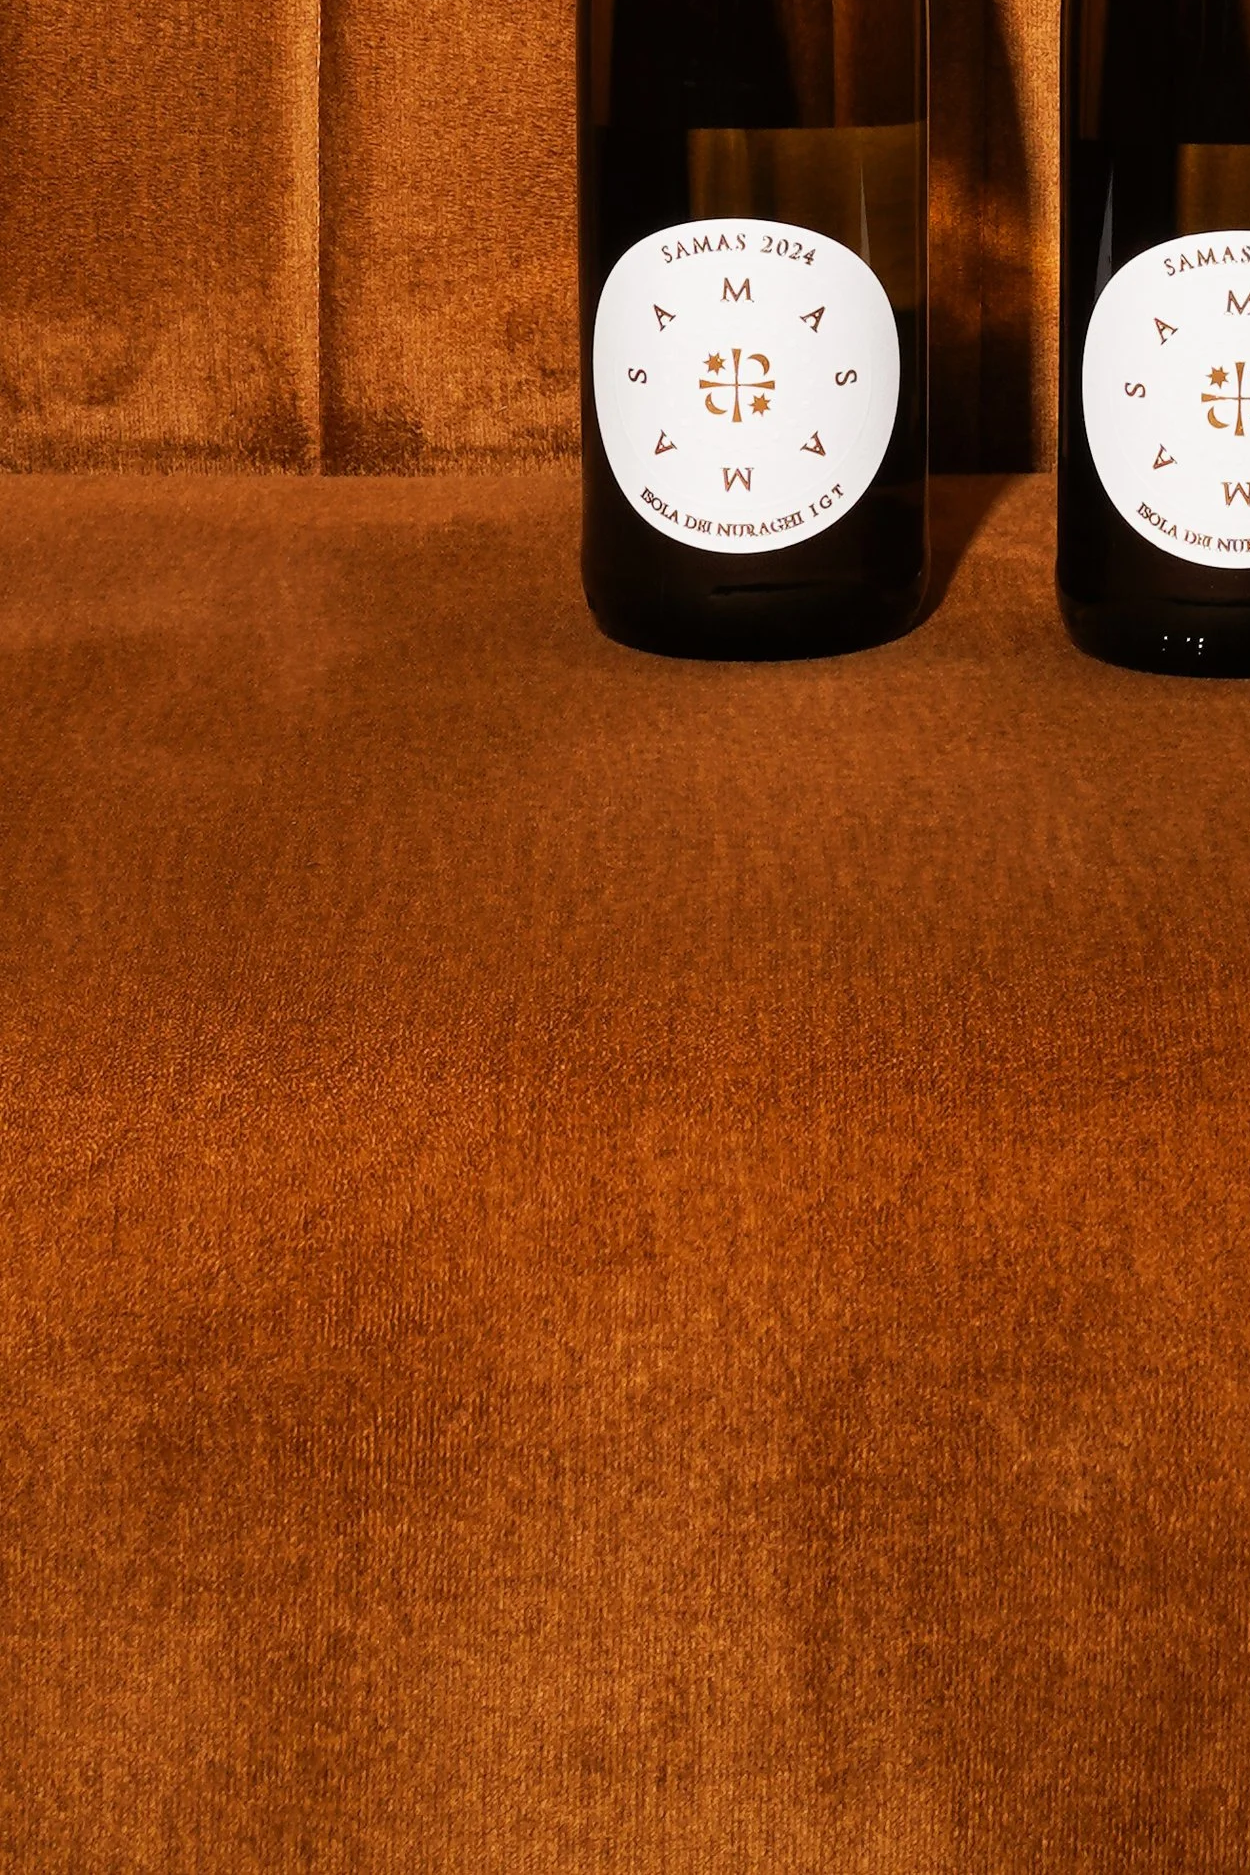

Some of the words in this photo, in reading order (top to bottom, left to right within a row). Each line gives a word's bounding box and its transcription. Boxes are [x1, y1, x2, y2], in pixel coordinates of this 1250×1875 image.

[660, 233, 748, 265] SAMAS
[760, 235, 817, 267] 2024
[640, 486, 680, 525] ISOLA
[683, 513, 714, 536] DEI
[715, 509, 806, 540] NURAGHI
[1136, 501, 1179, 541] ISOLA
[1183, 528, 1214, 551] DEI
